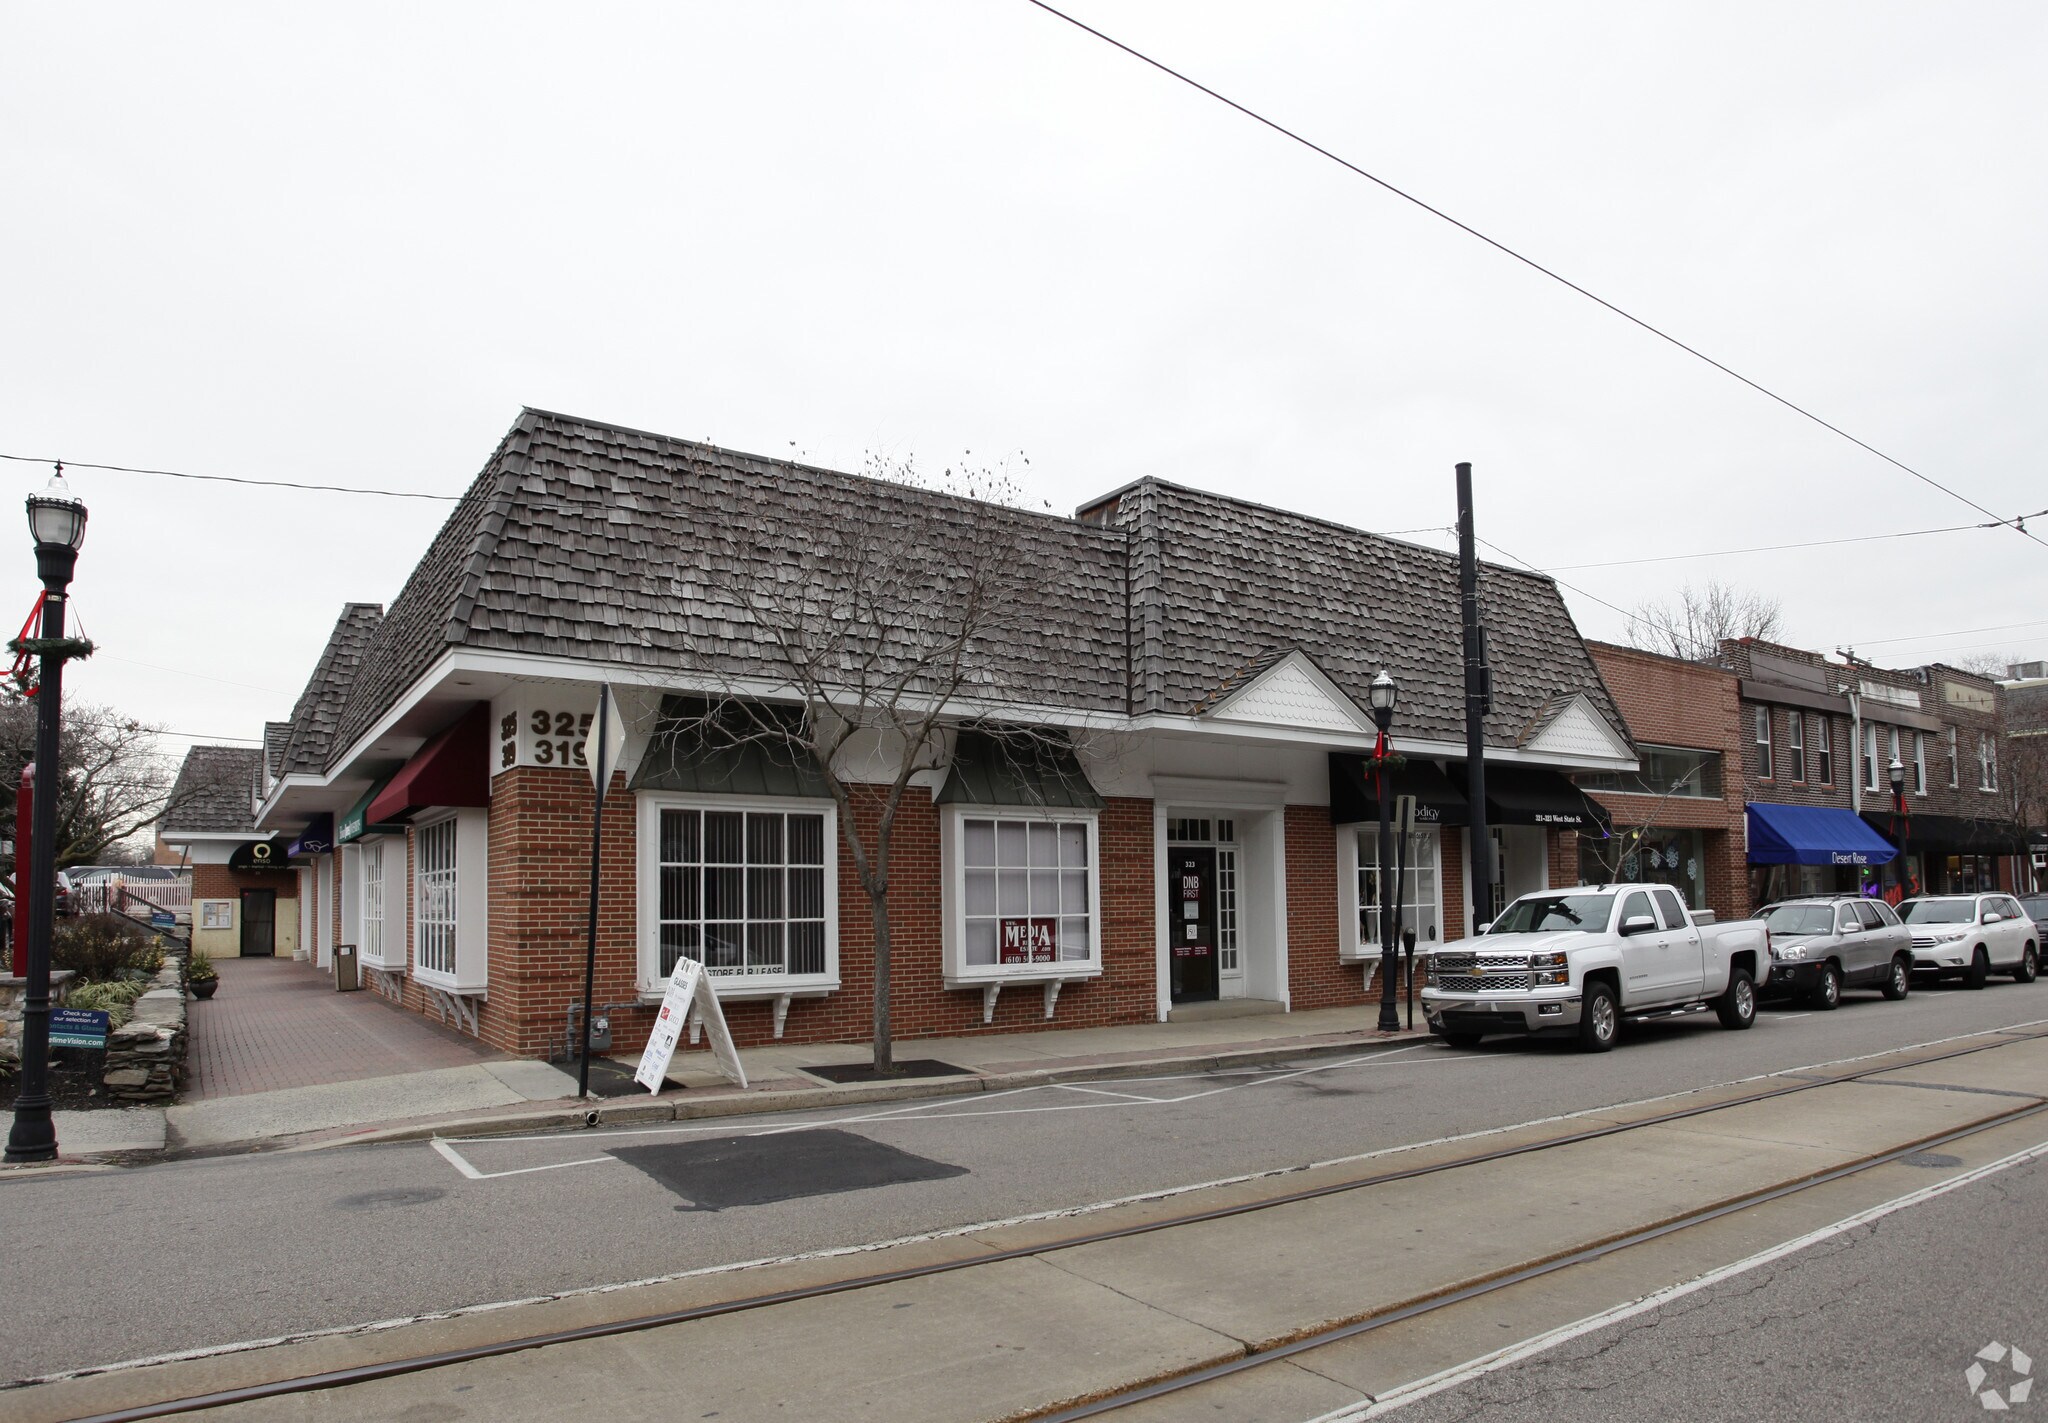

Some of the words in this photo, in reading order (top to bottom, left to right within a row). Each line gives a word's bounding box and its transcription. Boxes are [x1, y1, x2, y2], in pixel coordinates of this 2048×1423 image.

[531, 710, 594, 737] 325
[535, 740, 588, 766] 319
[1414, 805, 1440, 820] odigy
[1553, 814, 1563, 822] West
[1564, 815, 1575, 823] State
[1831, 851, 1852, 864] Desert
[1853, 852, 1867, 864] Rose
[1183, 875, 1199, 889] DNB
[1183, 889, 1200, 899] FIRST
[1005, 925, 1051, 947] MEDIA
[1005, 955, 1022, 964] (610)
[49, 1036, 104, 1046] etimeVision.com
